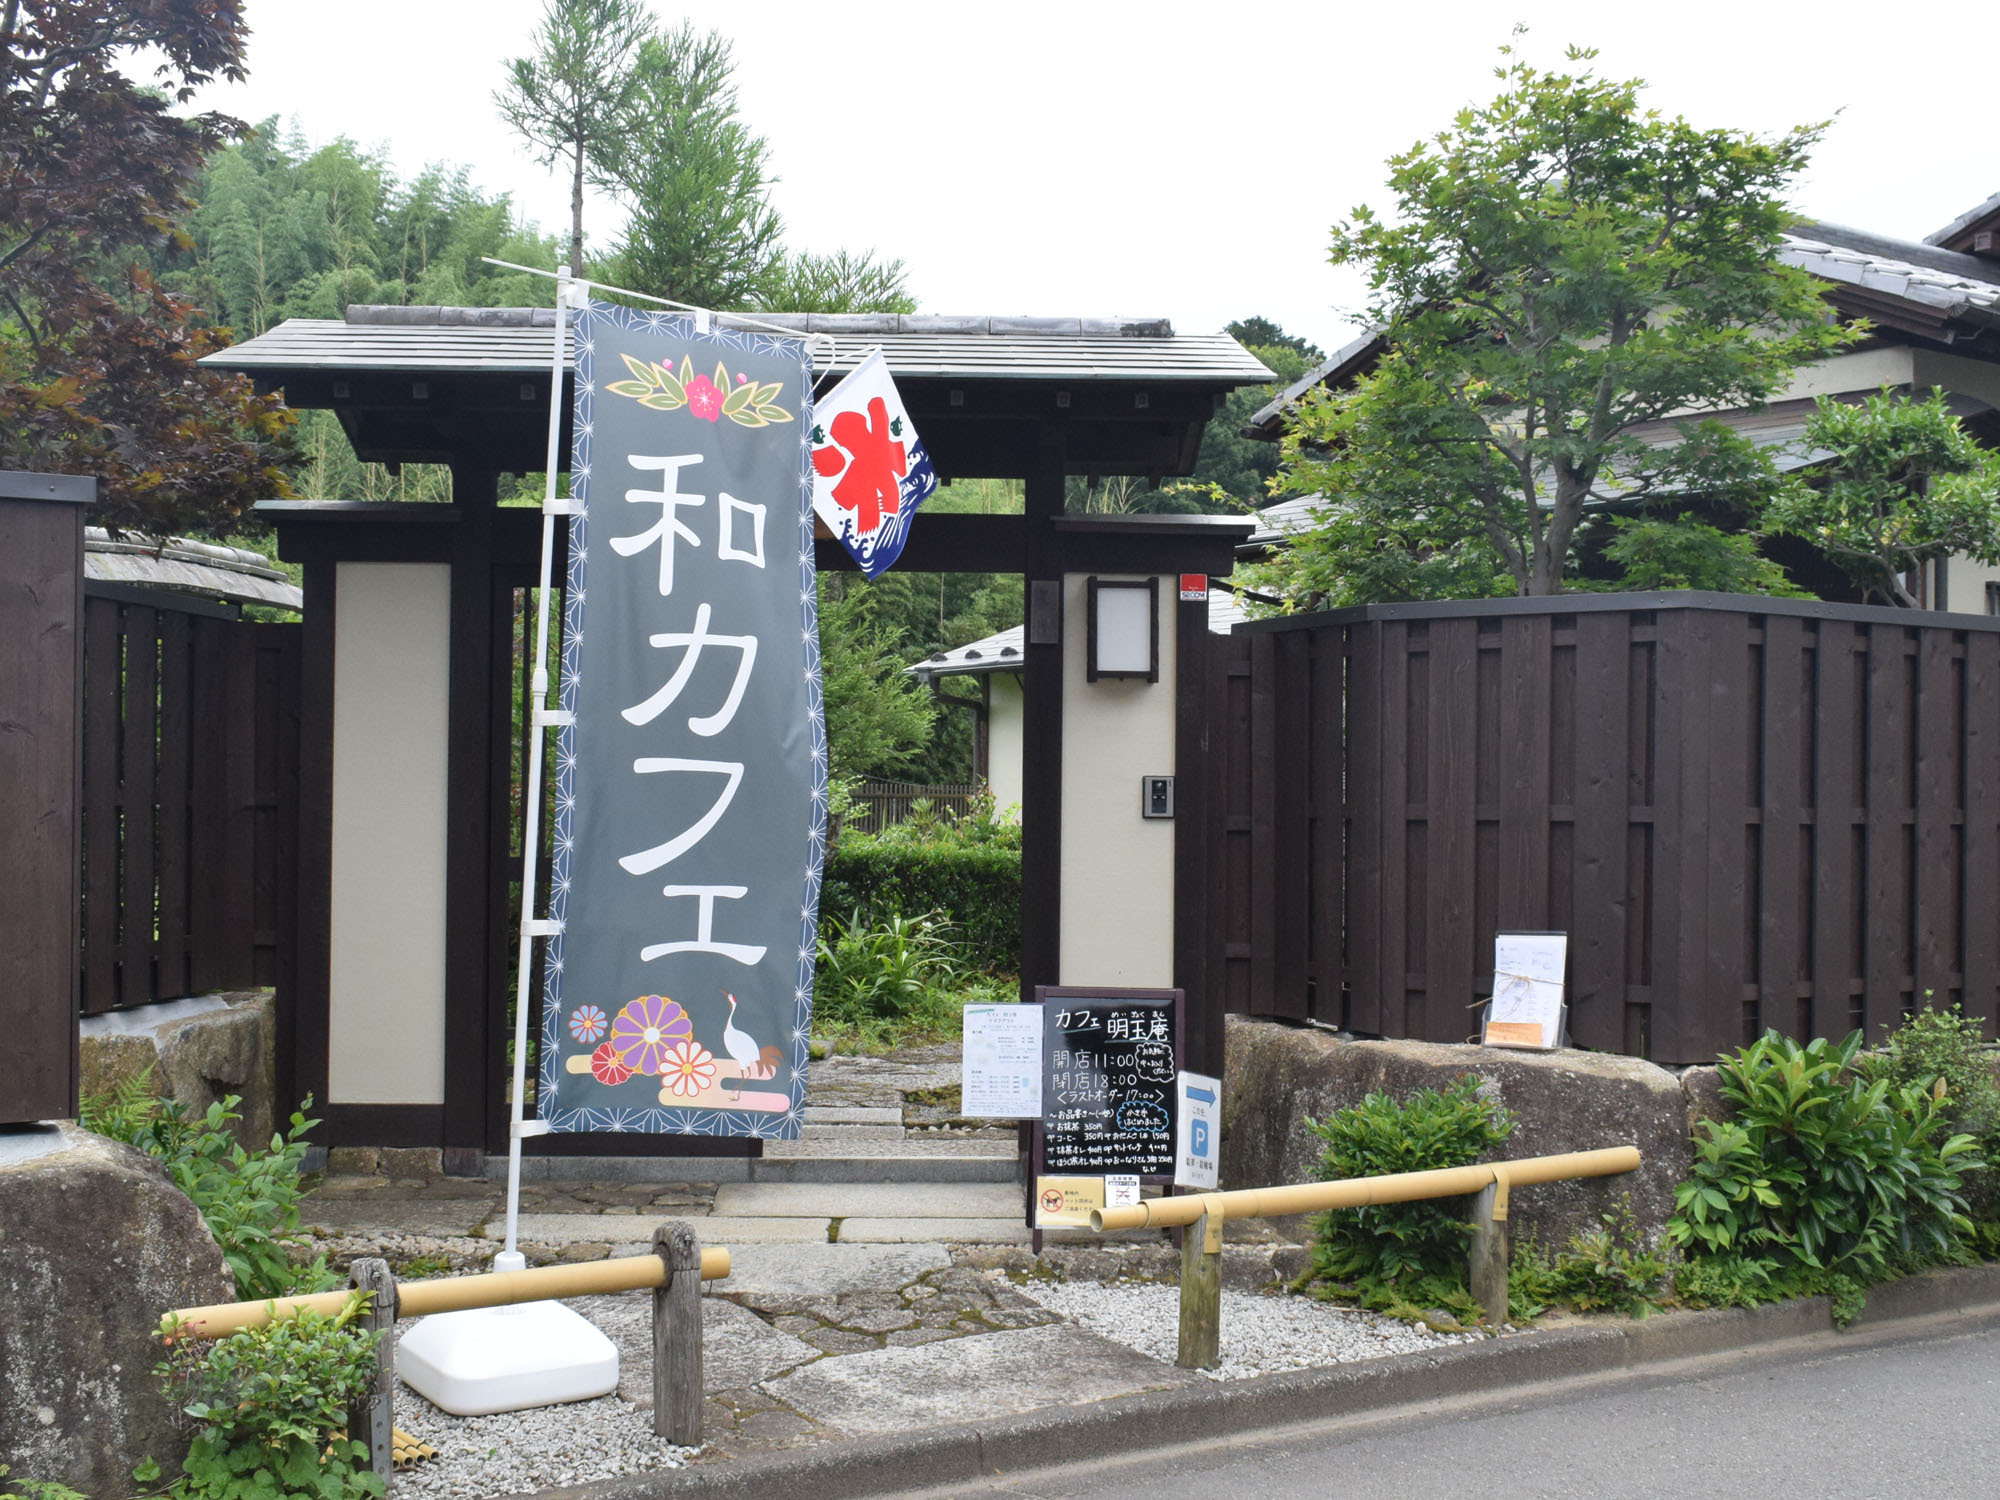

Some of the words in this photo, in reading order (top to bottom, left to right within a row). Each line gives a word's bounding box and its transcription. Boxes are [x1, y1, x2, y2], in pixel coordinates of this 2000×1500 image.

[812, 397, 907, 536] 氷
[609, 453, 767, 965] 和カフェ
[1055, 1009, 1100, 1028] カフェ
[1107, 1016, 1169, 1041] 明玉庵
[1084, 1123, 1103, 1131] 350円
[1084, 1132, 1104, 1141] 350円
